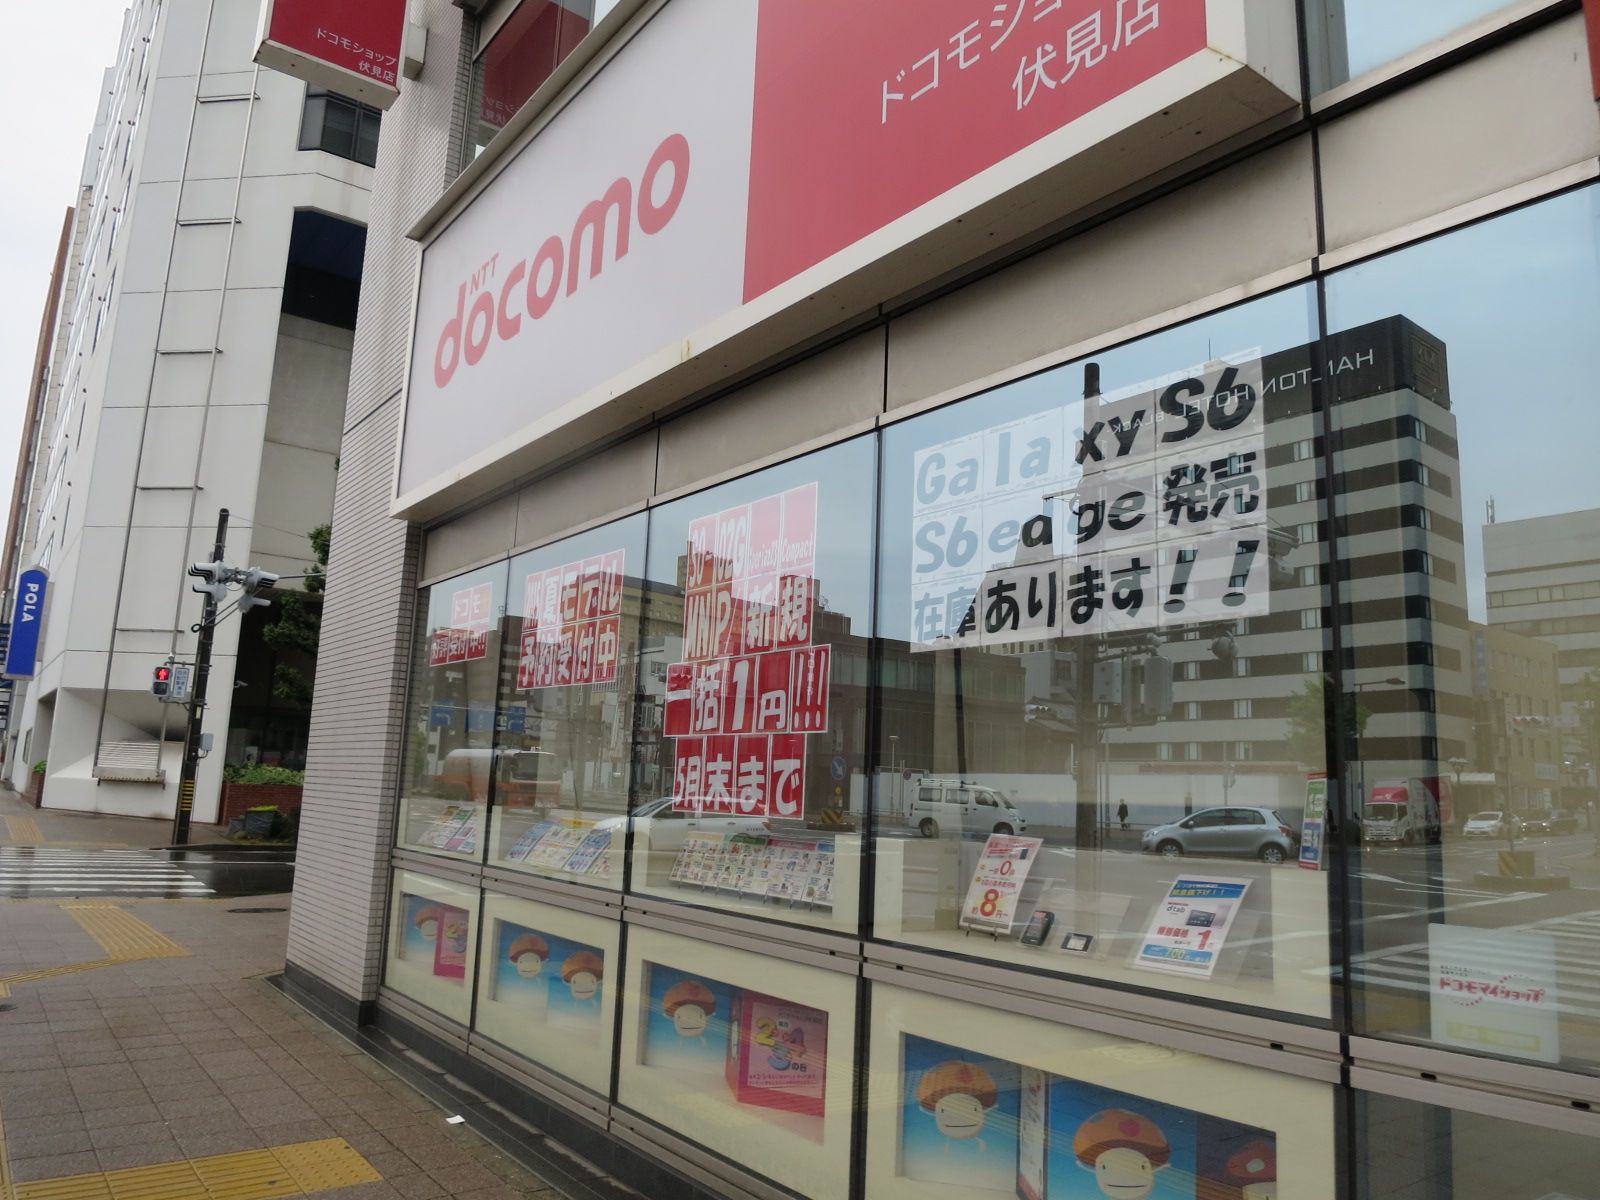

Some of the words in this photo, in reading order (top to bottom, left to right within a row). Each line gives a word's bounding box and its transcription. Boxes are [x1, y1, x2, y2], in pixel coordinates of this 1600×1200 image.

[315, 27, 398, 67] ドコモショップ
[1012, 0, 1160, 111] 伏見店
[358, 60, 396, 83] 伏見店
[434, 133, 690, 388] docomo
[470, 252, 500, 295] NTT
[21, 583, 39, 622] POLA
